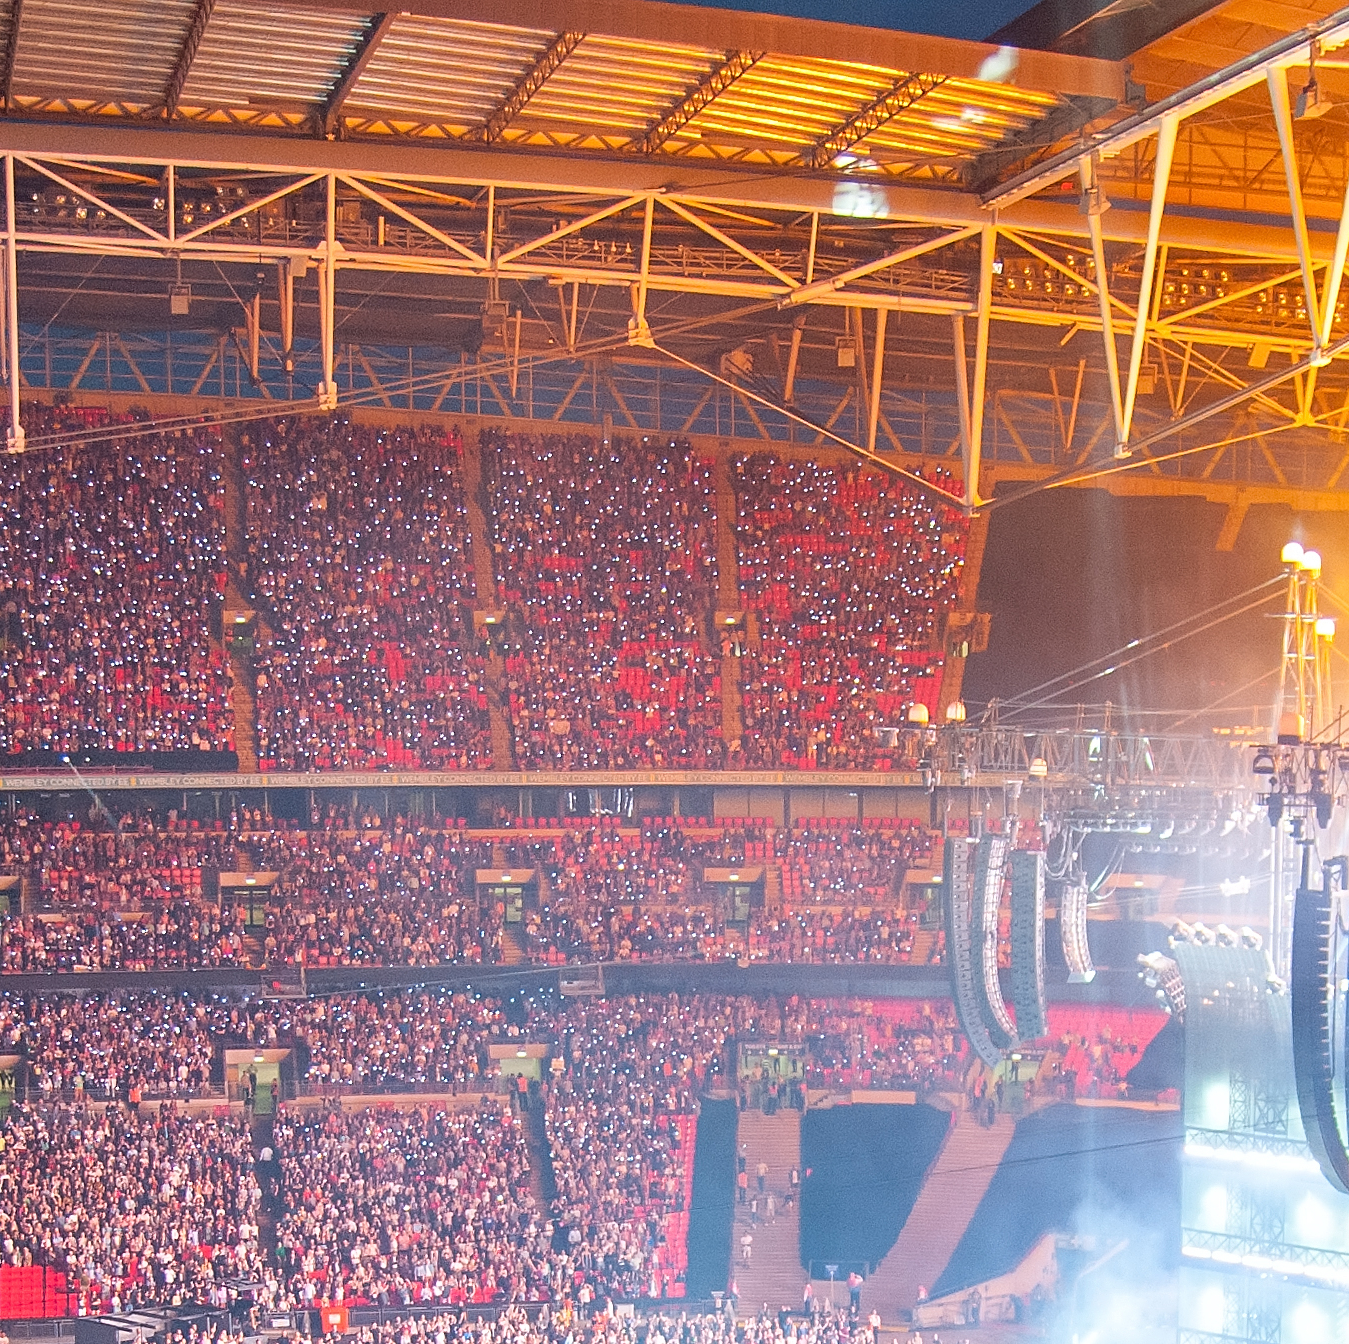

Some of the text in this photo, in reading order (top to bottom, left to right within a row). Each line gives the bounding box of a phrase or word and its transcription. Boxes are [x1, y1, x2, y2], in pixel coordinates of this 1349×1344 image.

[6, 778, 49, 787] WEMBLEY
[50, 778, 103, 786] CONNECTED
[139, 778, 181, 786] WEMBLEY
[182, 777, 236, 785] CONNECTED
[270, 776, 313, 784] WEMBLEY
[314, 776, 367, 784] CONNECTED
[401, 775, 442, 783] WEMBLEY
[443, 774, 496, 783] CONNECTED
[530, 774, 571, 782] WEMBLEY
[572, 774, 624, 782] CONNECTED
